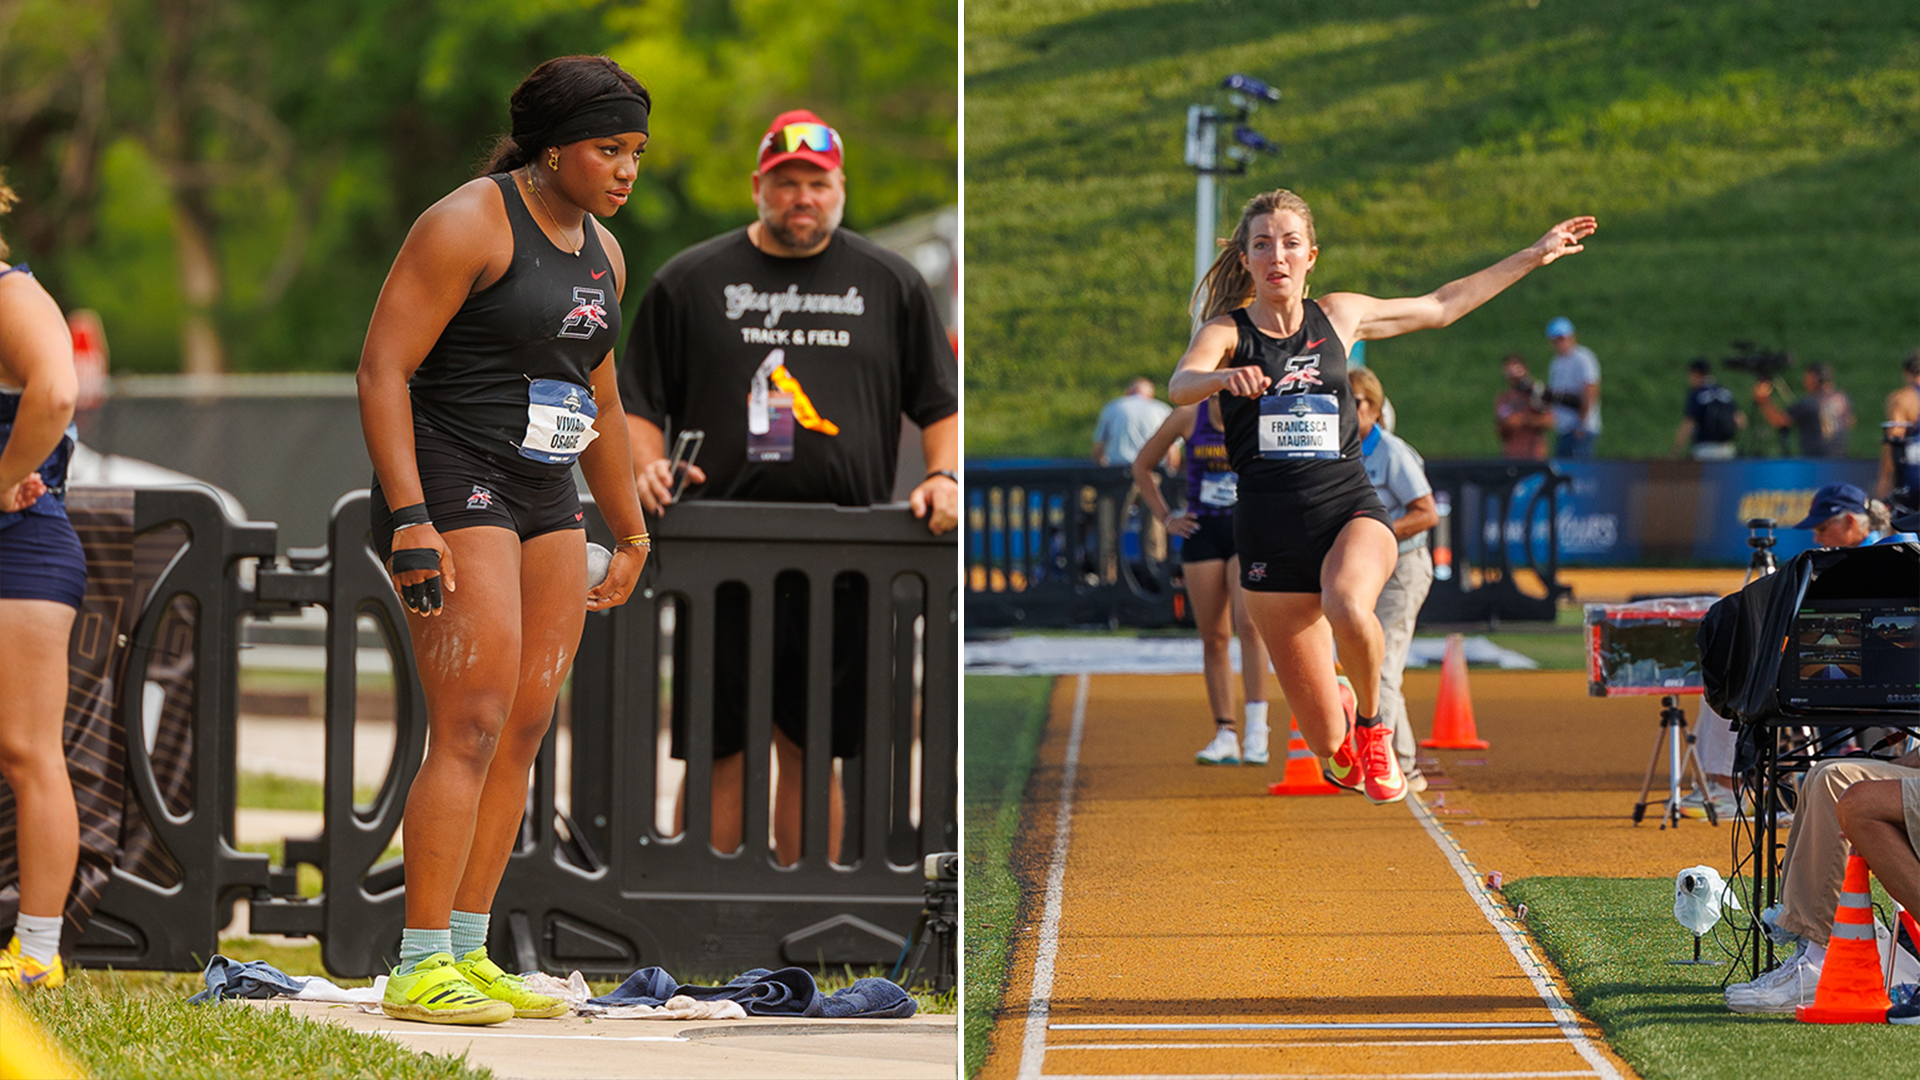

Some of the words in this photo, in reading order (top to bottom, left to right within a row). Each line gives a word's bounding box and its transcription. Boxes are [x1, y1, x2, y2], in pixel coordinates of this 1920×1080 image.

[724, 283, 865, 329] Greyhounds
[741, 327, 790, 345] TRACK
[792, 329, 805, 345] &
[807, 329, 850, 347] FIELD
[1271, 420, 1328, 433] FRANCESCA
[1277, 435, 1323, 447] MAURINO
